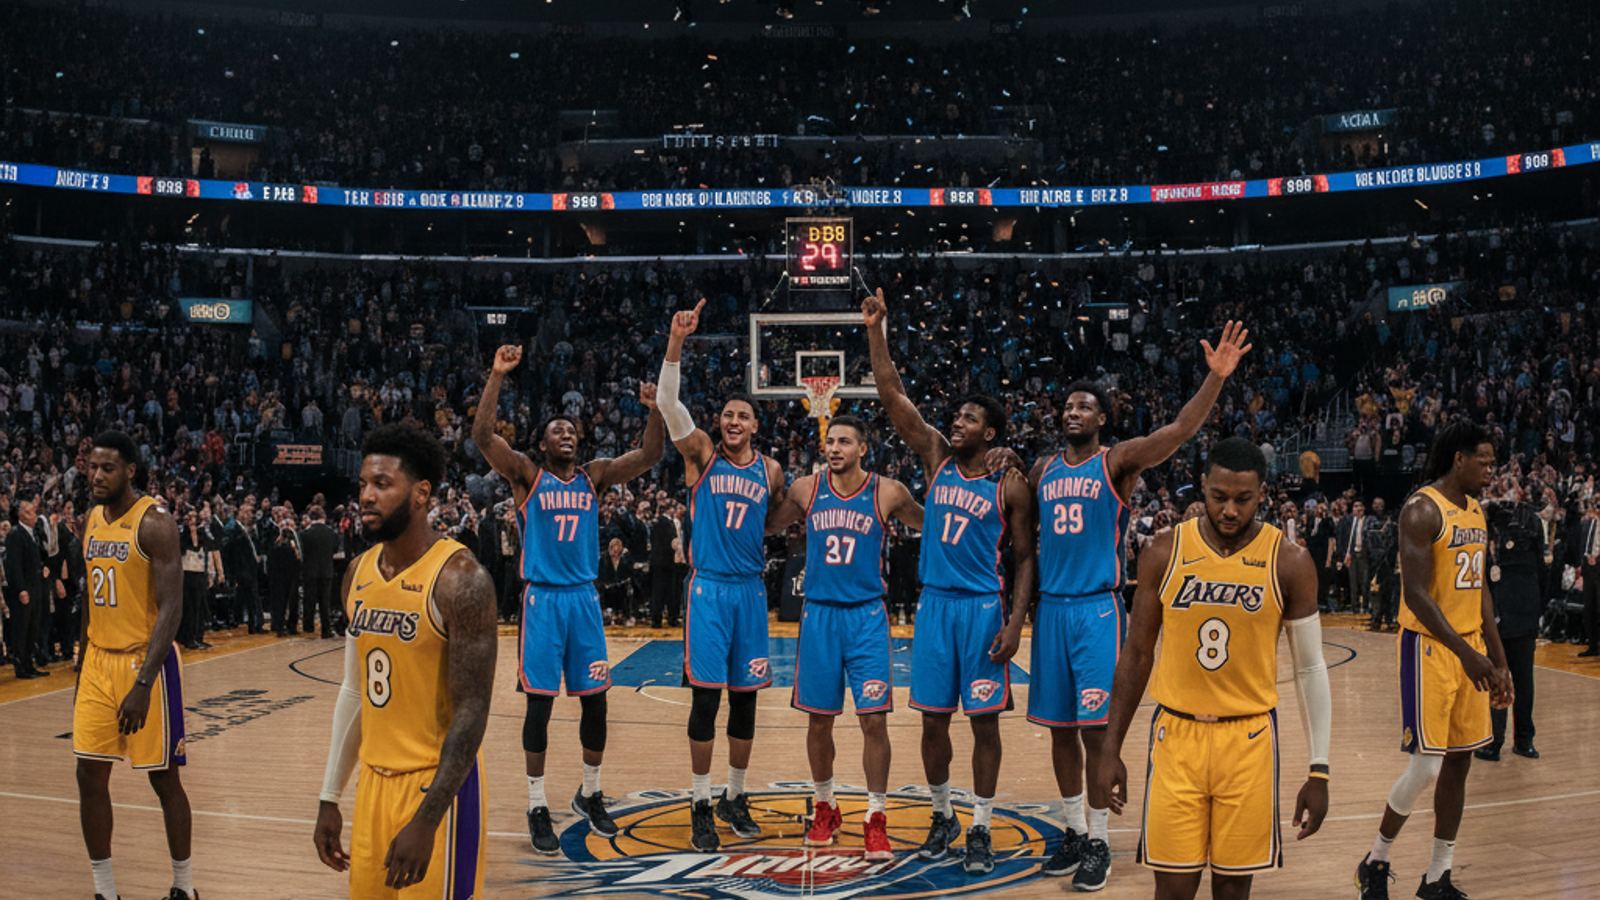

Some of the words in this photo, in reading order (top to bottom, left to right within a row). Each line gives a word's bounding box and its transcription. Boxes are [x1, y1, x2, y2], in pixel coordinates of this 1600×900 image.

[1054, 503, 1084, 535] 29
[92, 566, 118, 607] 21
[1195, 616, 1231, 672] 8
[366, 647, 392, 708] 8
